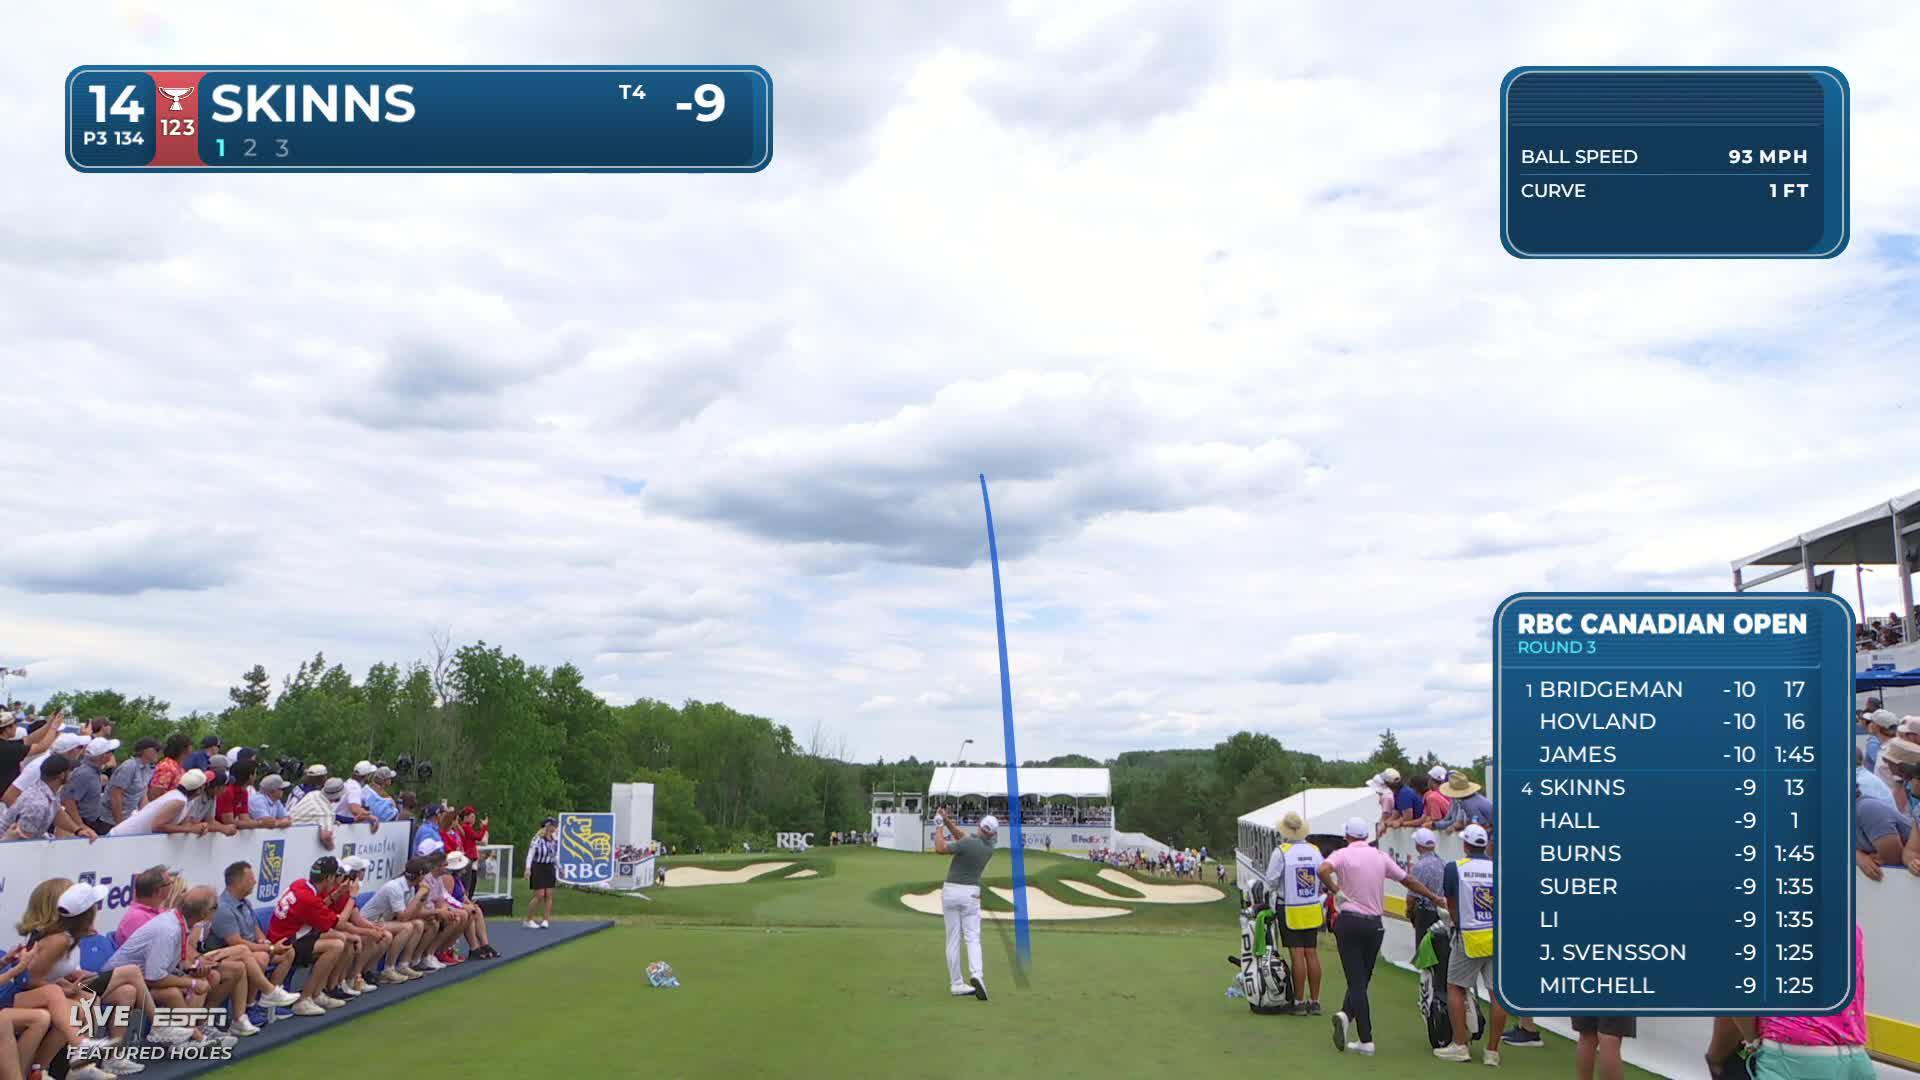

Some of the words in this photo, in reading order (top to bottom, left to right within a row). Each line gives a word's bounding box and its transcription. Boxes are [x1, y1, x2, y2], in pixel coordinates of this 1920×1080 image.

[876, 815, 892, 828] 14
[776, 832, 815, 848] RBC
[367, 858, 393, 881] PEN
[563, 863, 609, 879] RBC
[258, 884, 280, 899] RBC
[1298, 888, 1316, 897] RBC
[1242, 933, 1256, 997] PING
